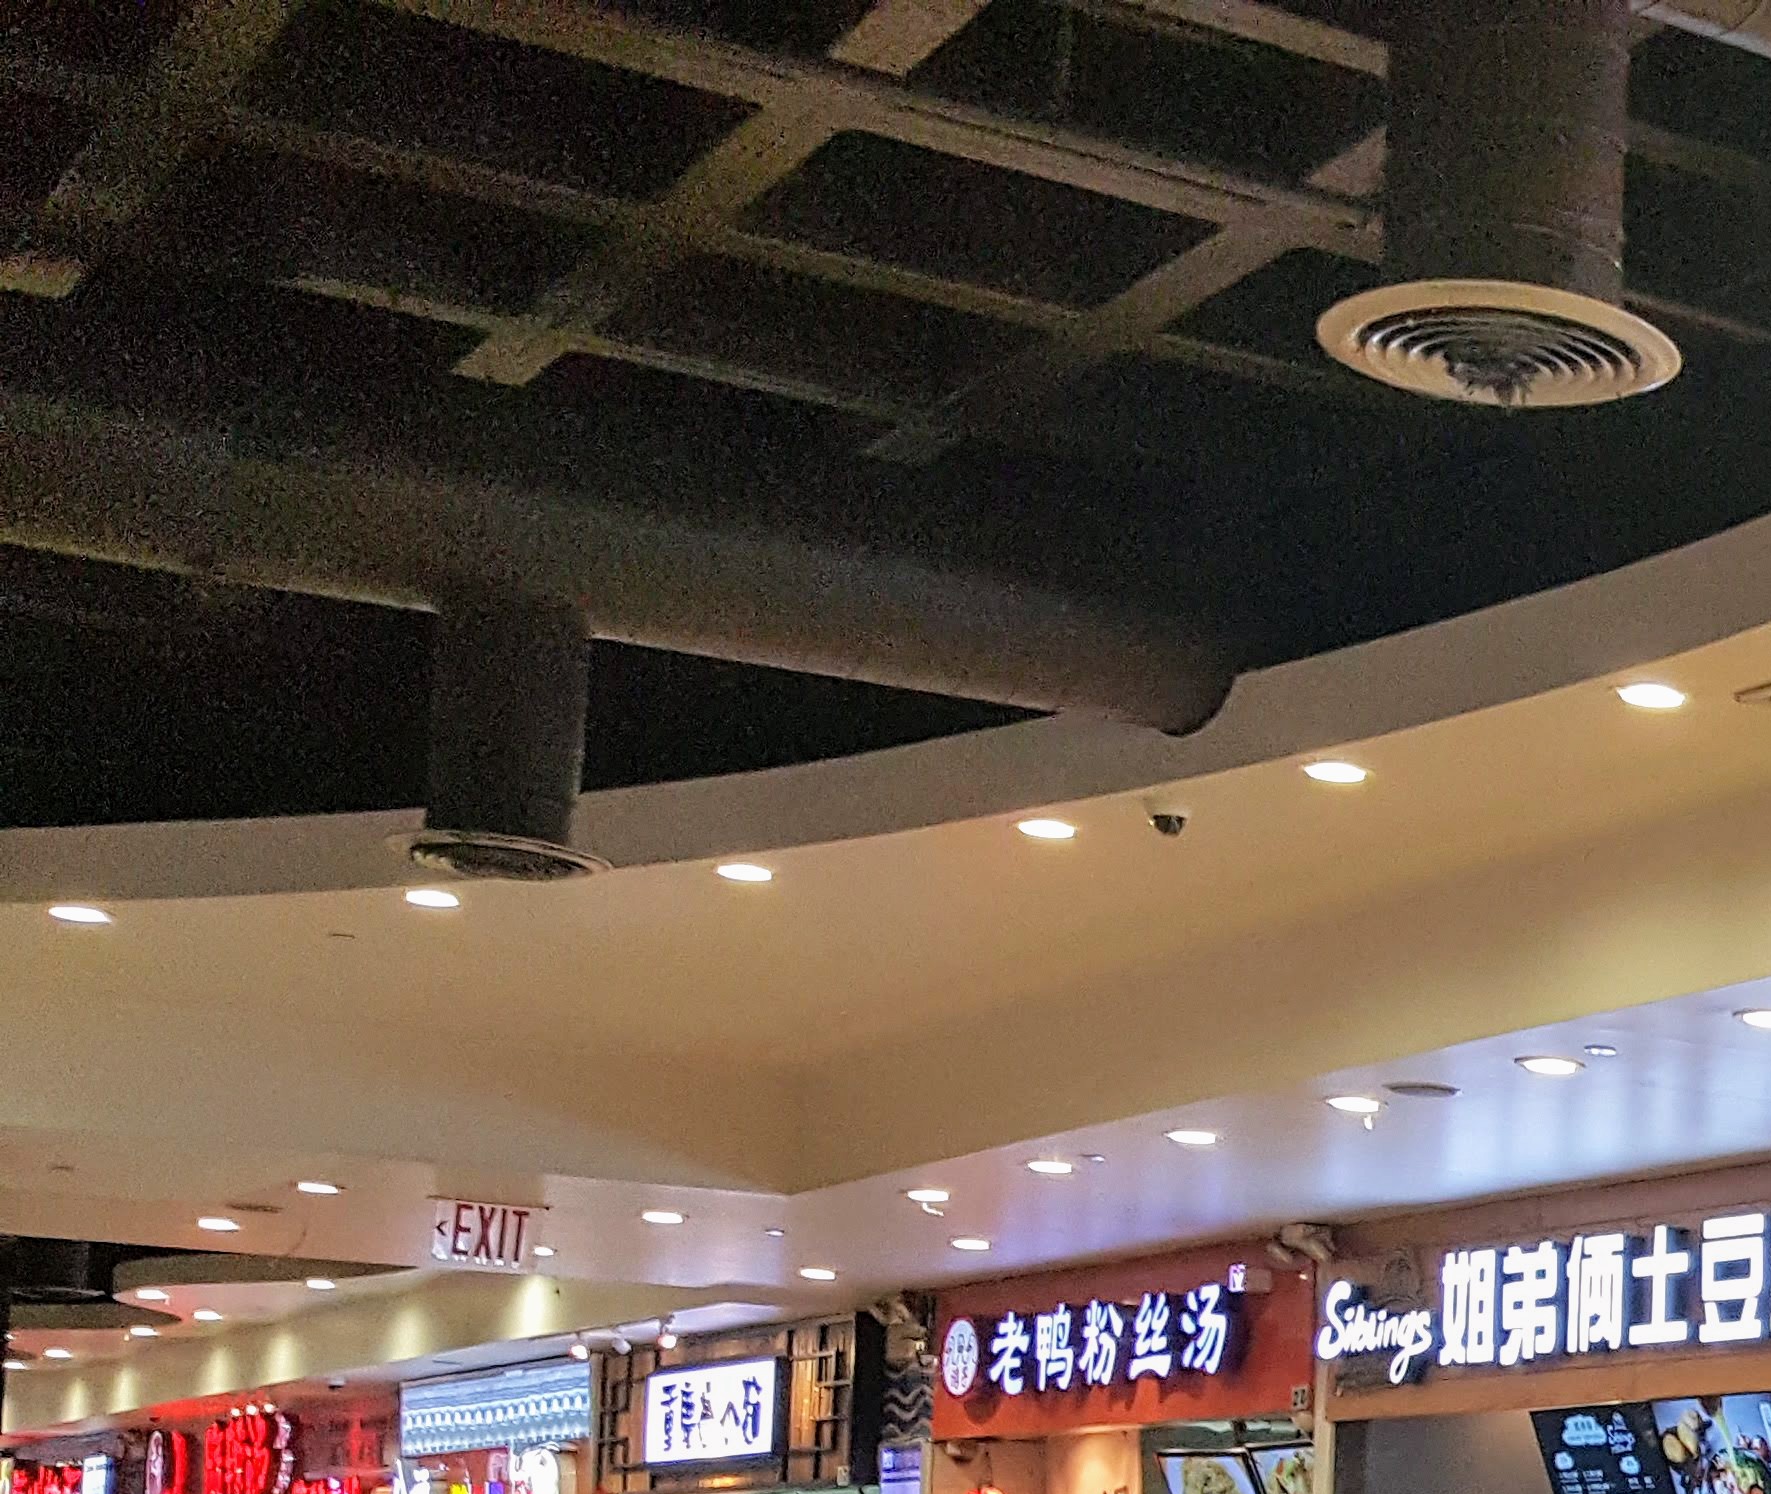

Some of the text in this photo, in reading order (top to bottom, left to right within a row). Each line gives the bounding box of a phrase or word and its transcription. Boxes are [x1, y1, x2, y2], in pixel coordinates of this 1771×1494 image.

[451, 1201, 531, 1266] EXIT
[988, 1283, 1230, 1396] 老鸭粉丝汤
[1318, 1280, 1432, 1385] Siblings
